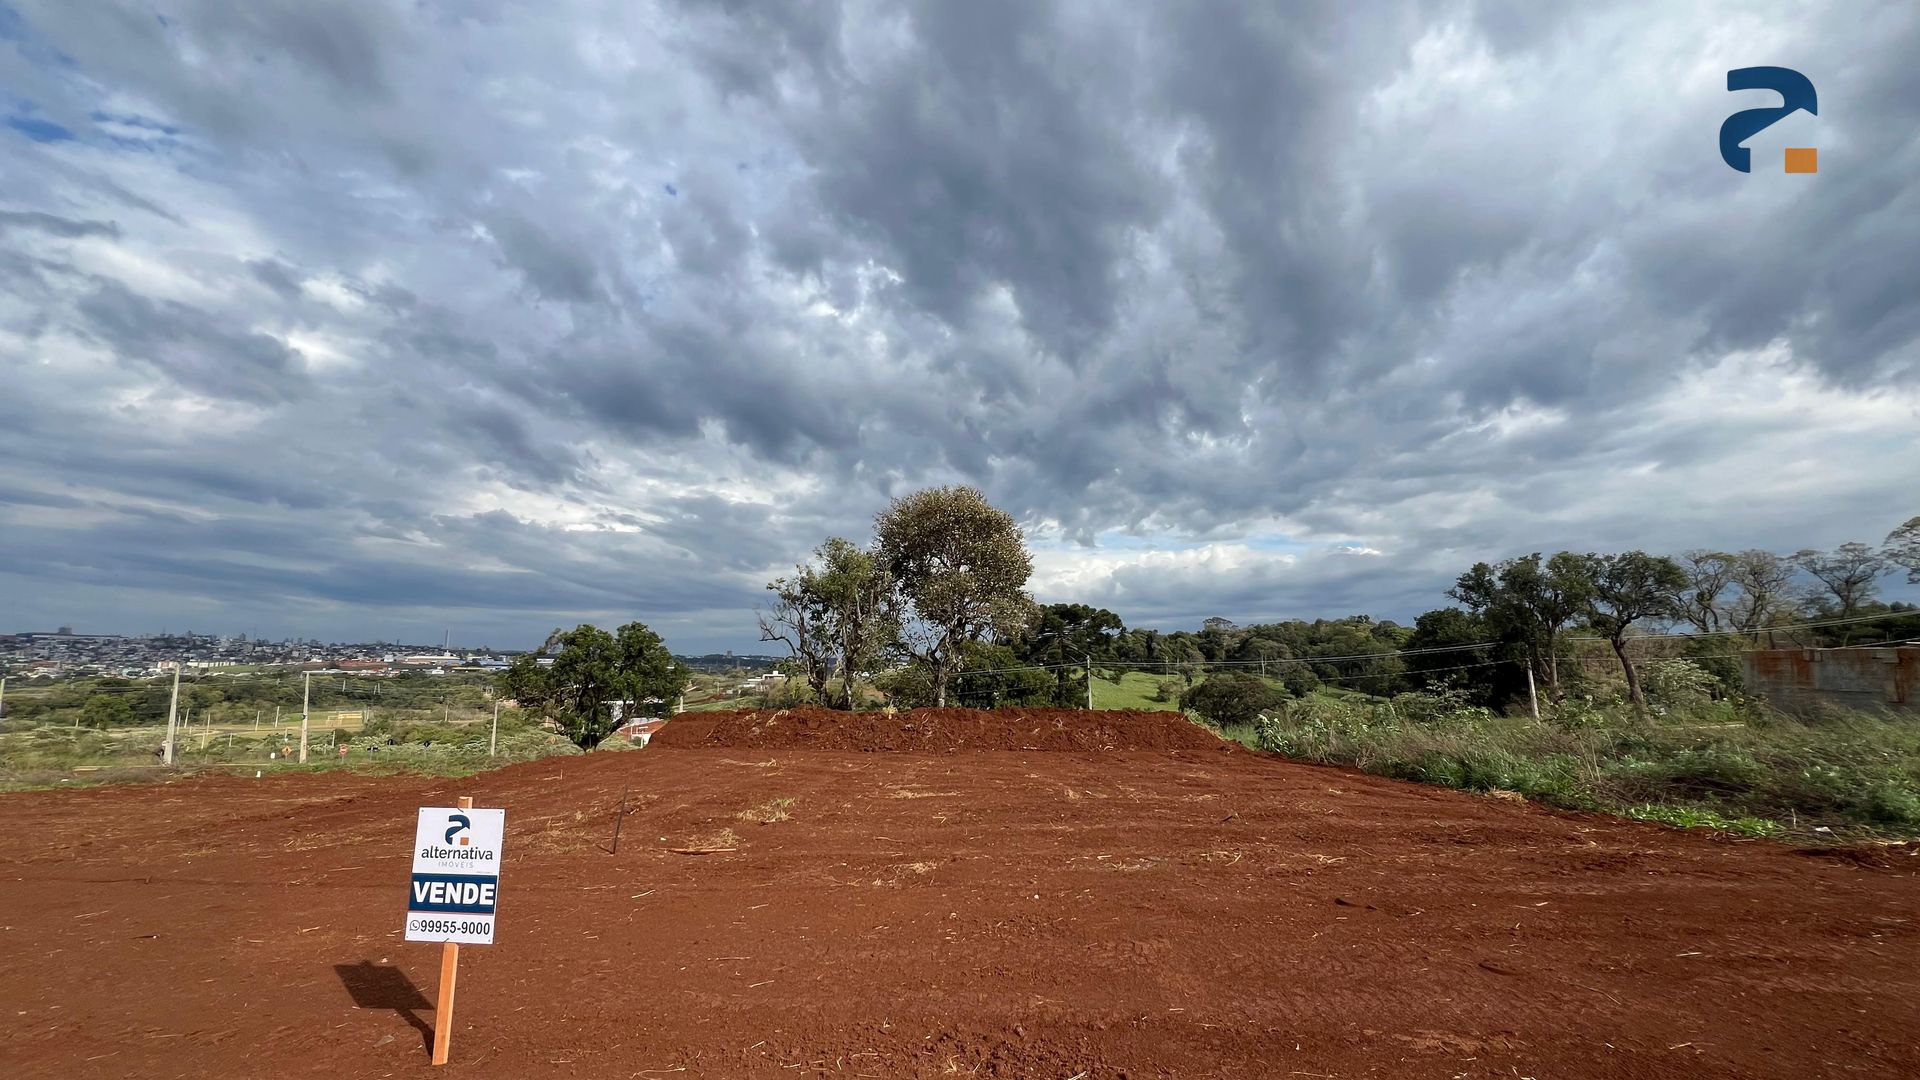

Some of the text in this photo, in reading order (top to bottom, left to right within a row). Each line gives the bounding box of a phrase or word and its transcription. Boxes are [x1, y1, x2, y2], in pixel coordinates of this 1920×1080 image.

[421, 846, 493, 860] alternativa
[438, 860, 474, 869] IMÓVEIS
[413, 881, 495, 905] VENDE
[420, 920, 490, 935] 99955-9000
